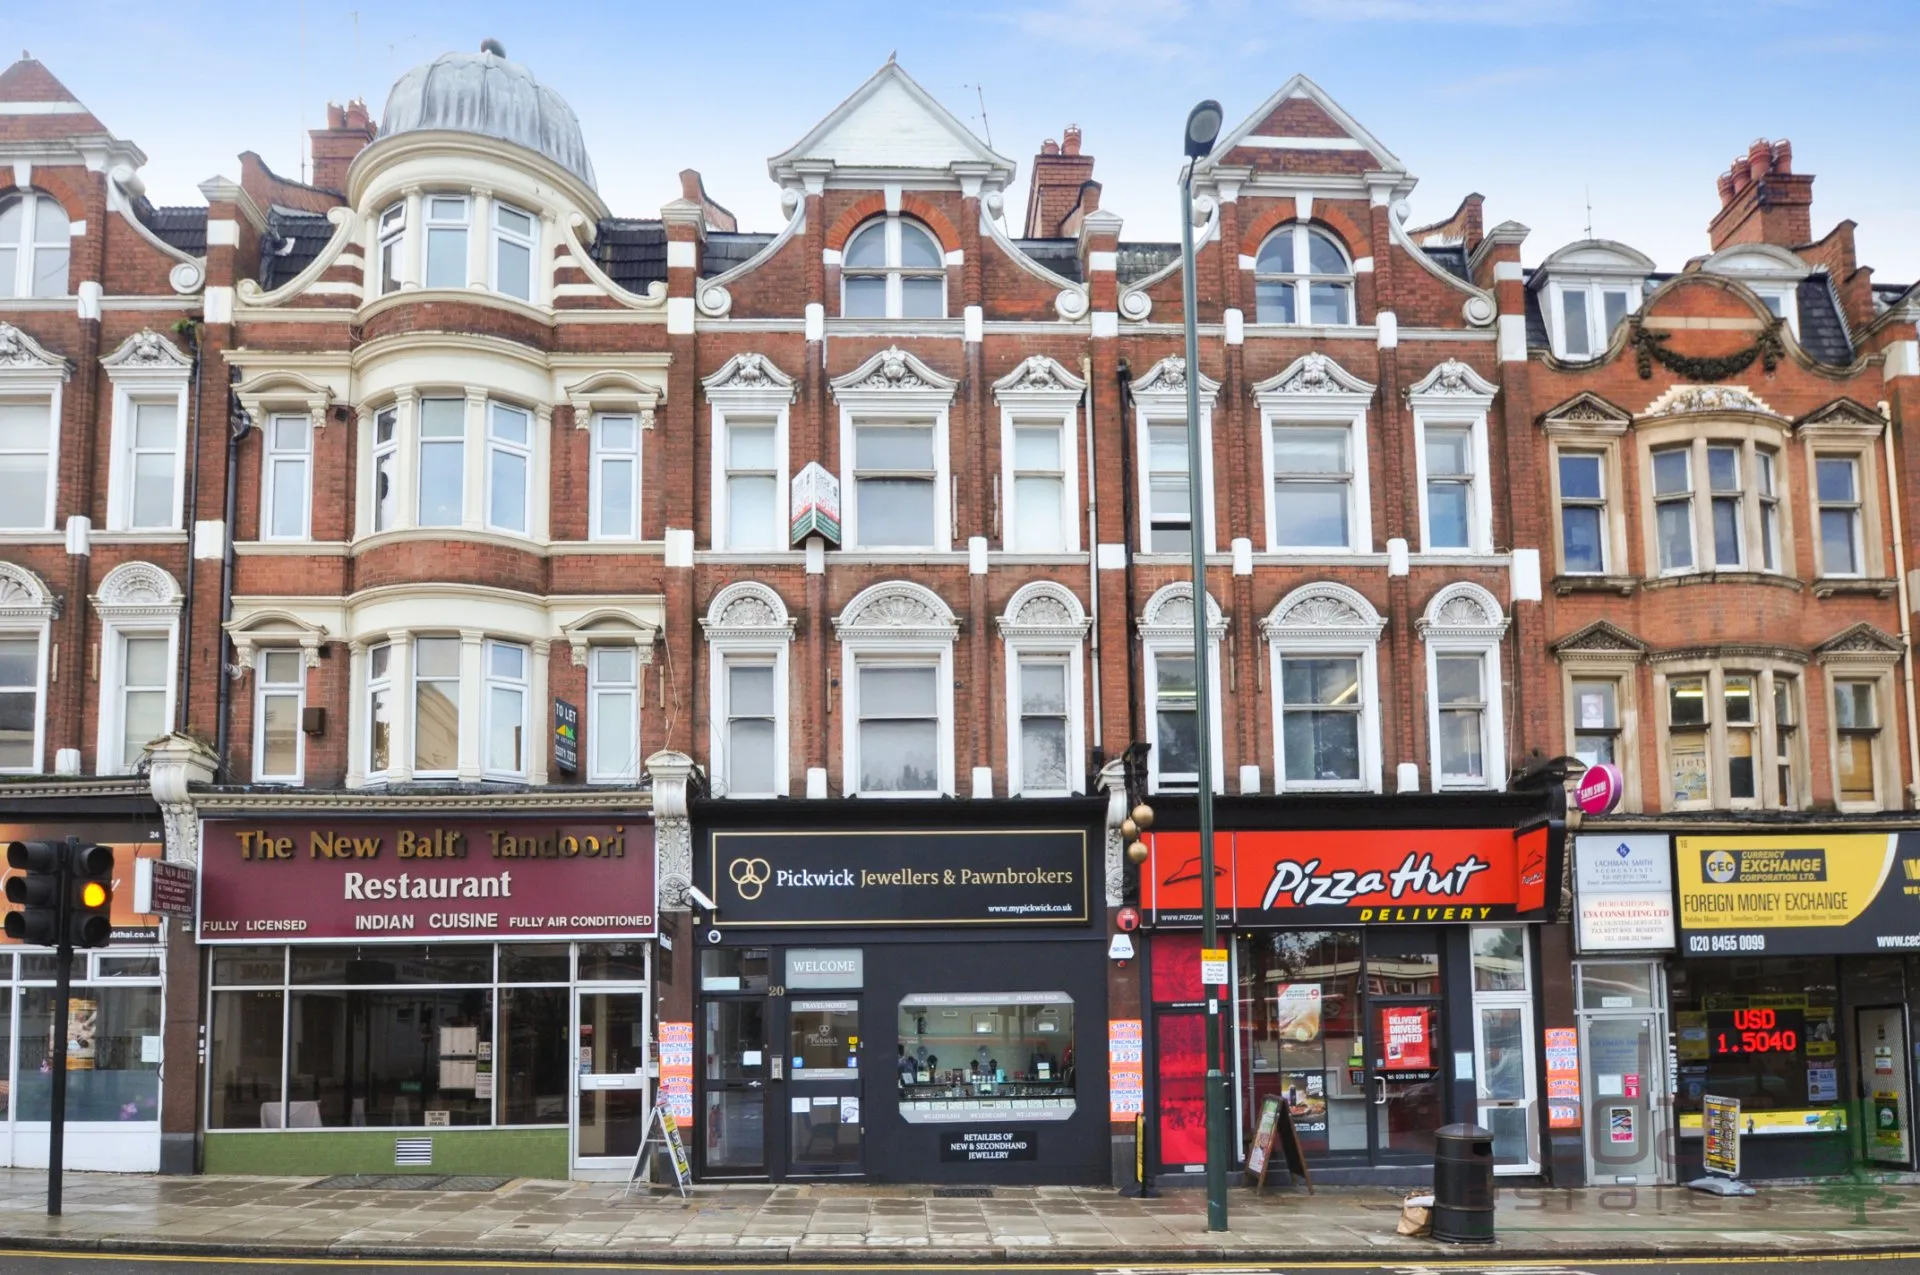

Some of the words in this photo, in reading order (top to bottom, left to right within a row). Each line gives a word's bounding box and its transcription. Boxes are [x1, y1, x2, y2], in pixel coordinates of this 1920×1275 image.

[555, 703, 564, 717] TO
[565, 708, 576, 723] LET
[235, 830, 293, 859] The
[310, 831, 381, 858] New
[397, 829, 466, 858] Balti
[487, 826, 625, 858] Tandoori
[1742, 851, 1785, 859] CURRENCY
[1708, 861, 1734, 872] CEC
[1740, 858, 1821, 873] EXCHANGE
[776, 868, 855, 886] Pickwick
[860, 868, 938, 888] Jewellers
[943, 869, 956, 885] &
[961, 867, 1073, 885] Pawnbrokers
[1262, 858, 1385, 911] Pizza
[1390, 852, 1489, 898] Hut
[1739, 873, 1798, 882] CORPORATION
[1799, 873, 1816, 881] LTD.
[344, 871, 512, 899] Restaurant
[1684, 894, 1734, 912] FOREIGN
[1738, 893, 1781, 912] MONEY
[1785, 892, 1848, 910] EXCHANGE
[988, 904, 1072, 914] www.mypickwick.co.uk
[1360, 907, 1491, 921] DELIVERY
[1600, 910, 1652, 918] CONSULTING
[1654, 909, 1669, 917] LTD
[203, 920, 239, 931] FULLY
[246, 920, 307, 931] LICENSED
[355, 914, 415, 930] INDIAN
[429, 913, 498, 929] CUISINE
[509, 917, 545, 928] FULLY
[547, 916, 567, 927] AIR
[571, 915, 652, 927] CONDITIONED
[1690, 936, 1709, 951] 020
[1712, 935, 1737, 951] 8455
[1739, 935, 1765, 950] 0099
[793, 960, 856, 972] WELCOME
[768, 986, 784, 996] 20
[1389, 1016, 1421, 1024] DELIVERY
[1734, 1009, 1775, 1030] USD
[661, 1025, 692, 1034] CIRCUS
[1111, 1023, 1140, 1031] CIRCUS
[1389, 1024, 1422, 1034] DRIVERS
[1390, 1034, 1422, 1044] WANTED
[1718, 1030, 1796, 1053] 1.5040
[662, 1077, 692, 1085] CIRCUS
[1111, 1072, 1141, 1080] CIRCUS
[1307, 1075, 1322, 1083] BIG
[1311, 1123, 1325, 1131] £20
[964, 1133, 1001, 1141] RETAILERS
[976, 1142, 1027, 1150] SECONDHAND
[968, 1152, 1009, 1160] JEWELLERY
